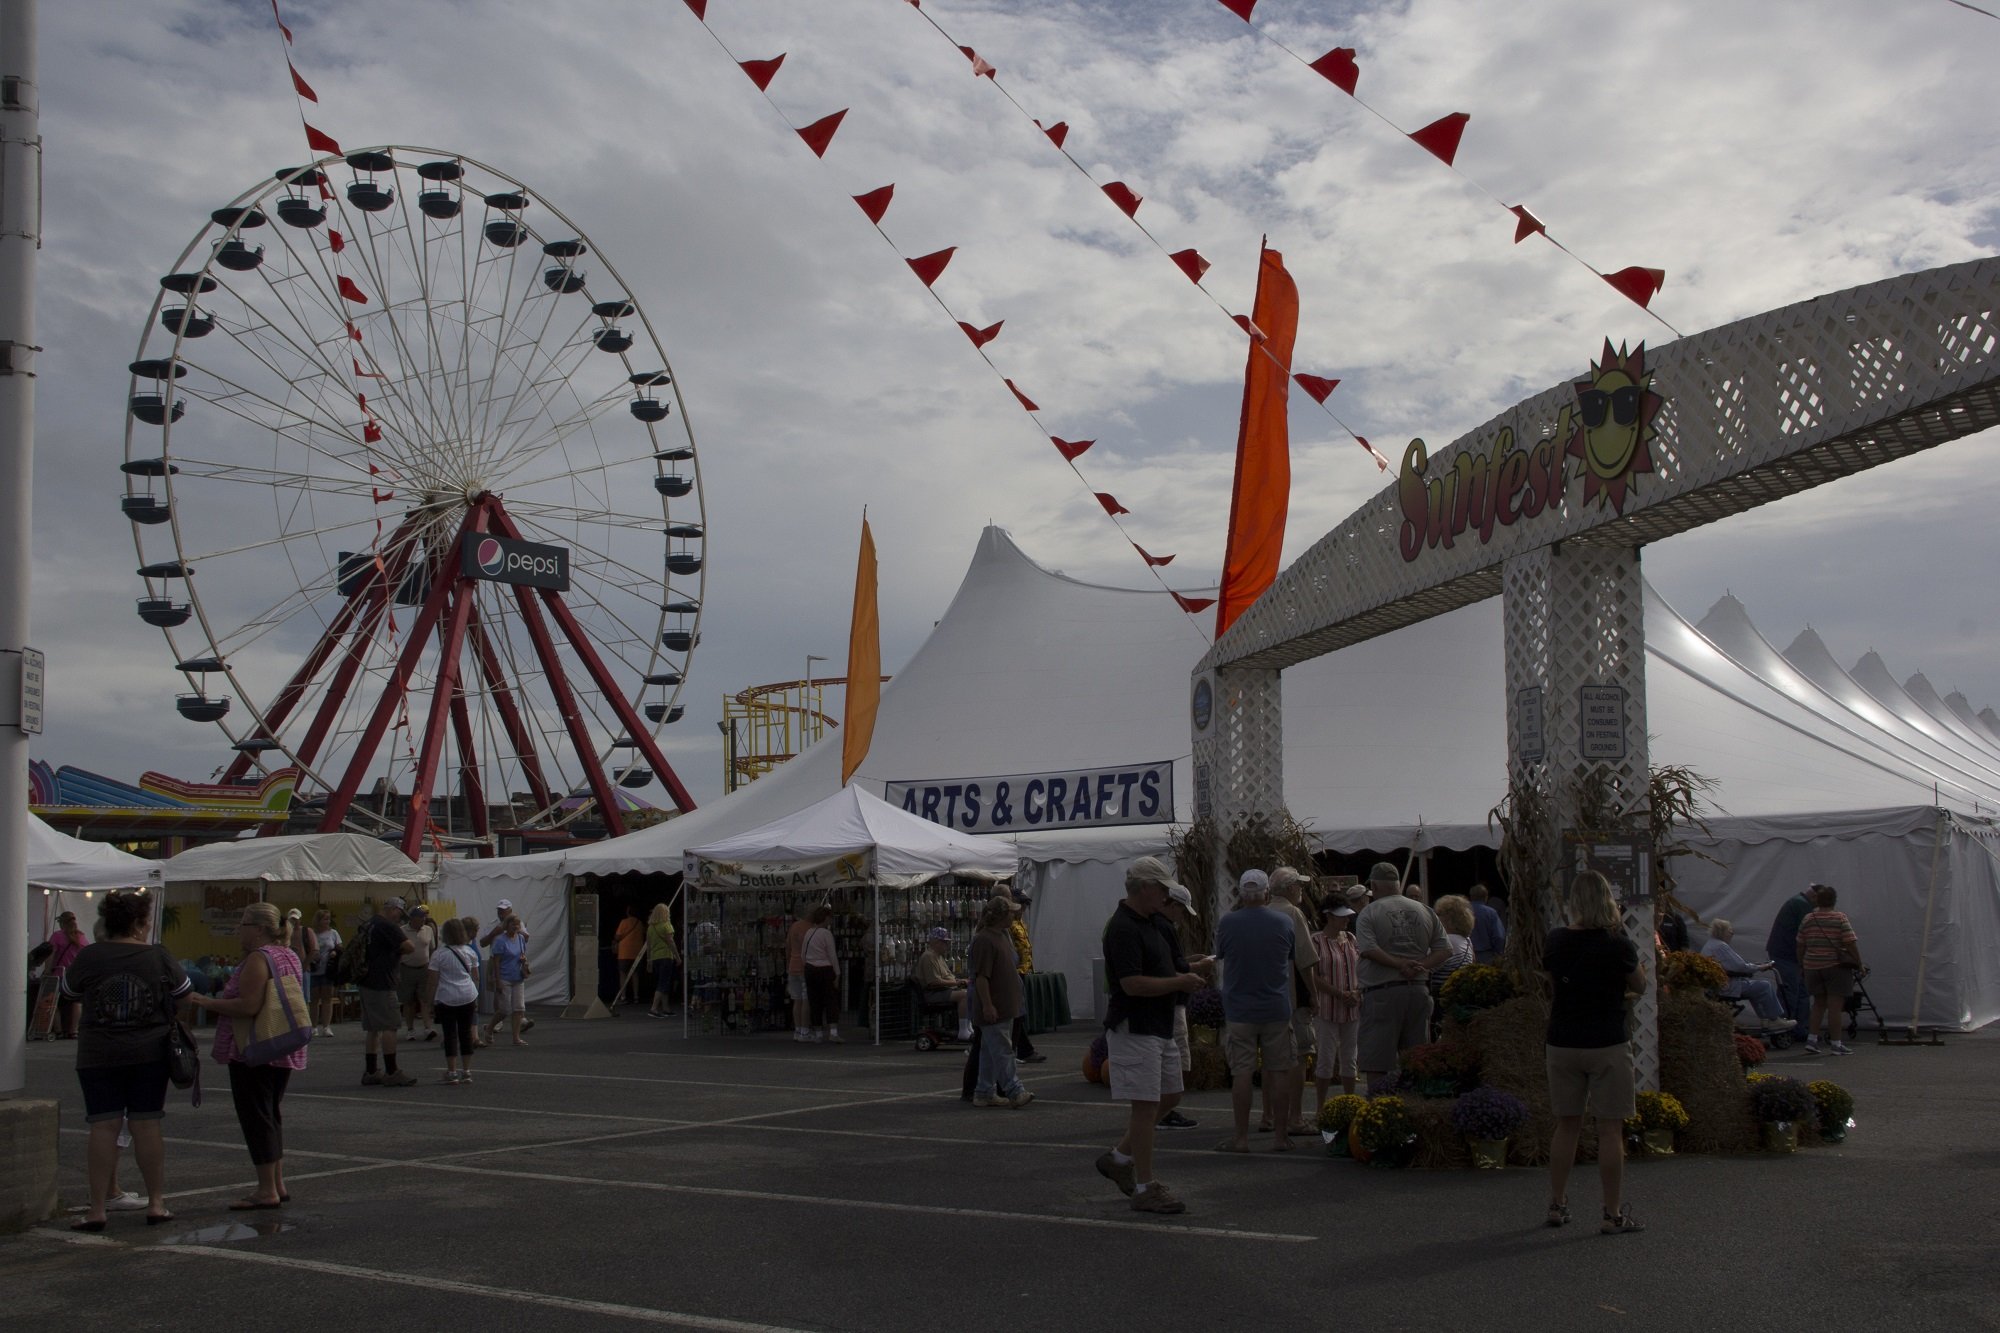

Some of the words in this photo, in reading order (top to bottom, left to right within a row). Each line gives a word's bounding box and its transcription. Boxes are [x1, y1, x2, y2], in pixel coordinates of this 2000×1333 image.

[1398, 403, 1574, 563] Sunfest
[507, 552, 559, 577] pepsi
[1595, 693, 1621, 701] ALCOHOL
[1590, 705, 1606, 714] MUST
[1607, 705, 1616, 714] BE
[1587, 718, 1619, 726] CONSUMED
[1596, 731, 1621, 739] FESTIVAL
[1590, 743, 1617, 752] GROUNDS
[902, 783, 981, 828] ARTS
[991, 781, 1013, 826] &
[1024, 770, 1161, 823] CRAFTS
[739, 873, 787, 887] Bottle
[791, 871, 820, 885] Art
